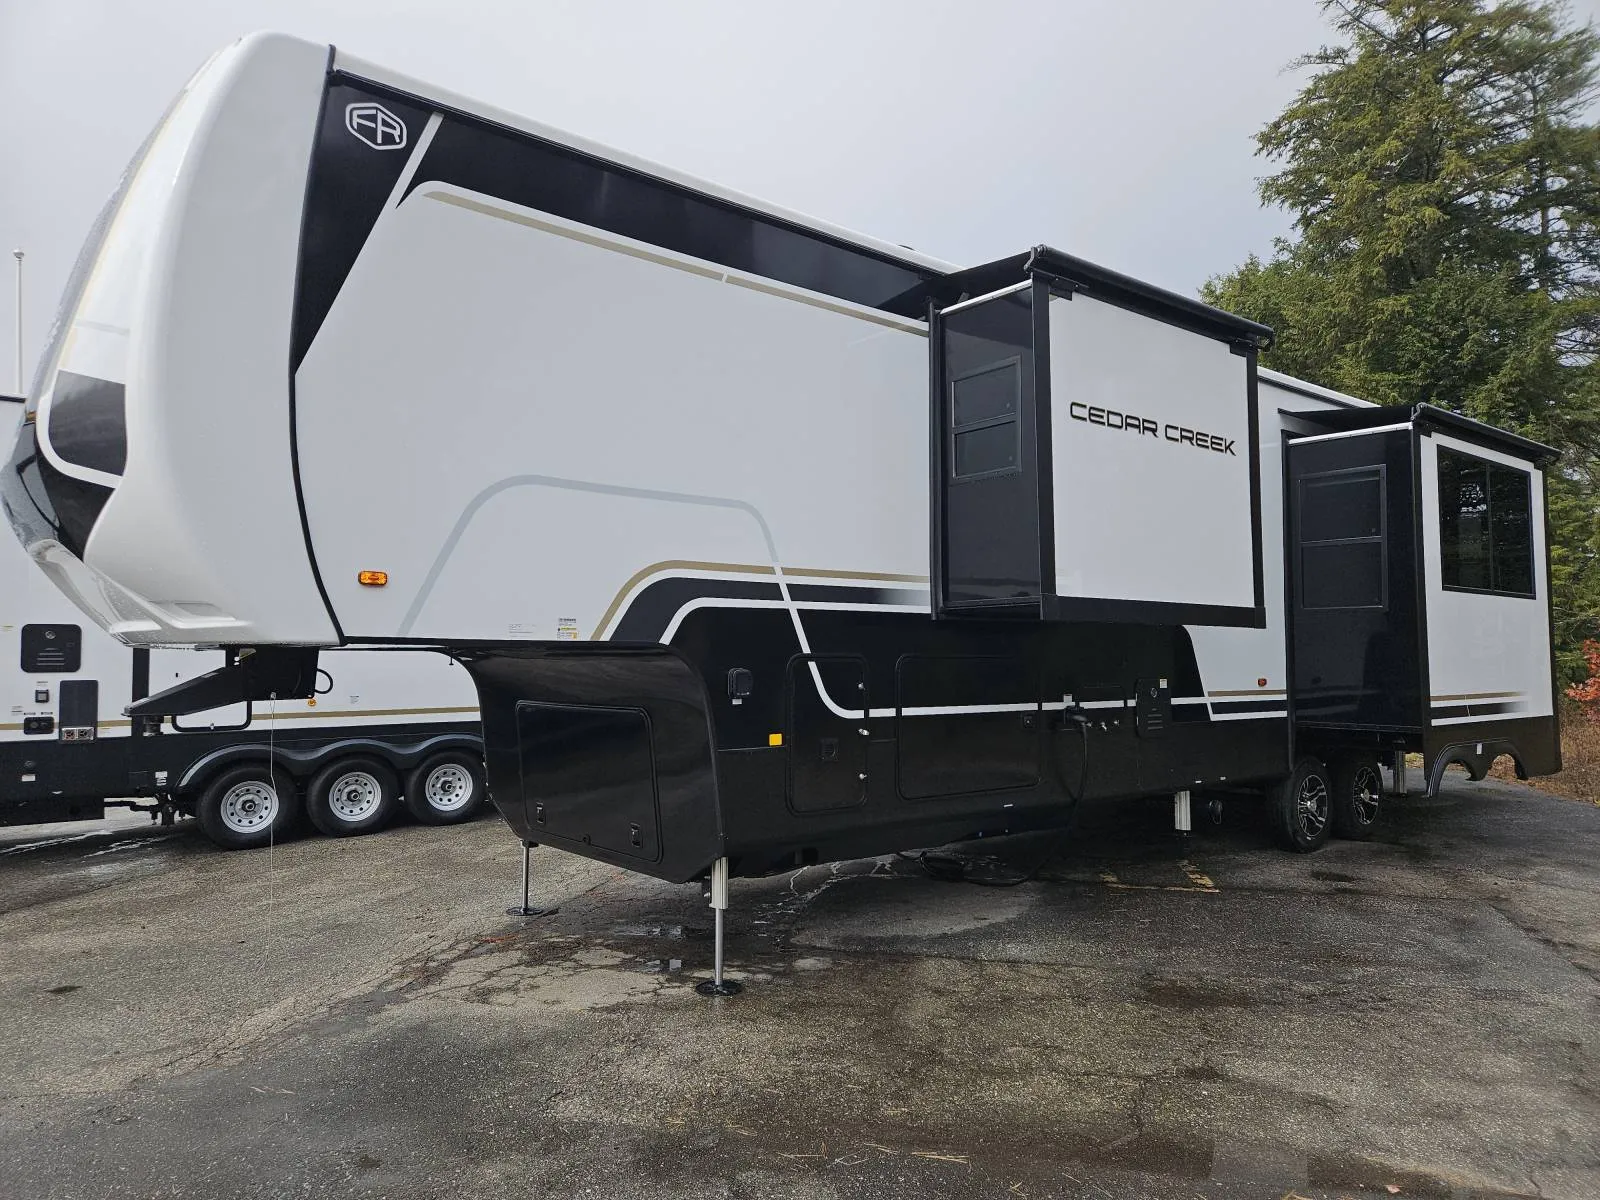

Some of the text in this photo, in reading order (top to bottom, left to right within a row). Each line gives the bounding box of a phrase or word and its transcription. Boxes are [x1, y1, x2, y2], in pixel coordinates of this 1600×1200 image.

[352, 109, 401, 144] FR
[1070, 401, 1237, 457] CEDAR CREEK
